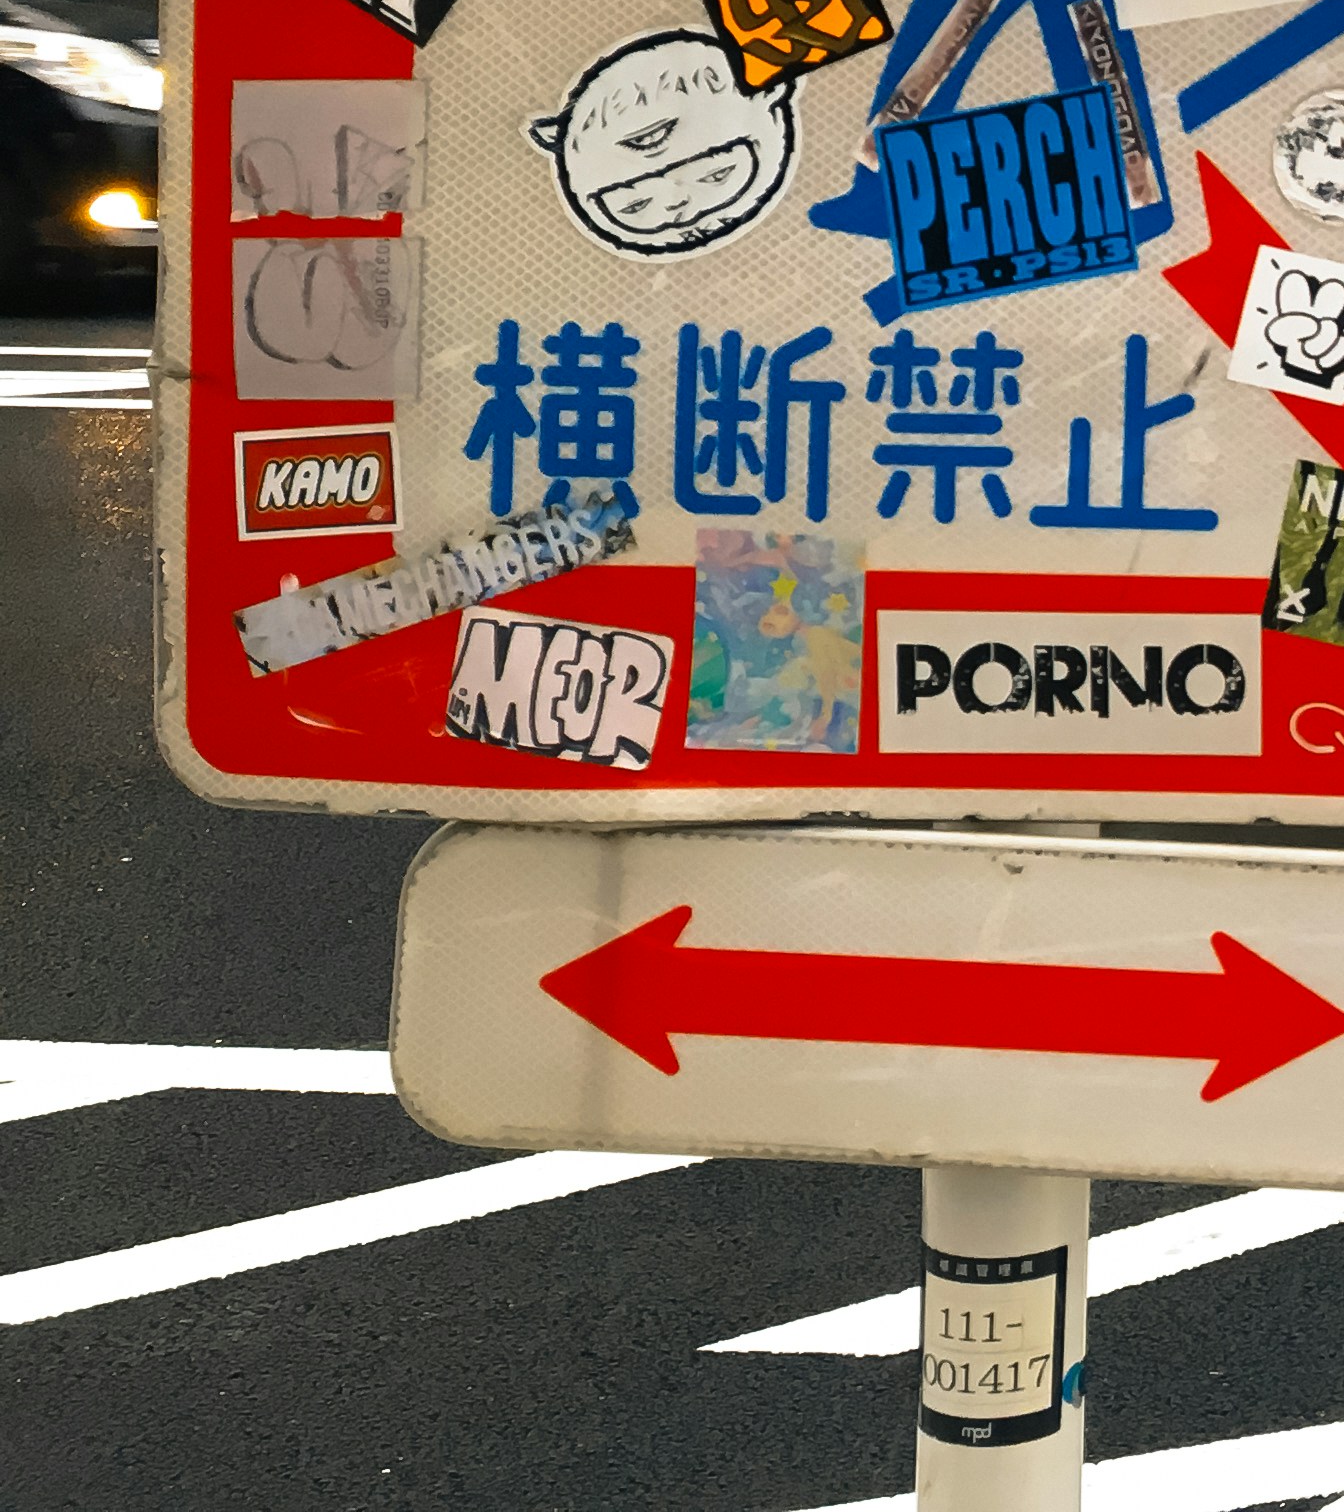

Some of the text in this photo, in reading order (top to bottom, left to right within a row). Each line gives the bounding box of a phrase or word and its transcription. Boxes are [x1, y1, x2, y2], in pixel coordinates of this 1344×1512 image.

[884, 94, 1127, 274] PERCH
[906, 237, 1131, 302] SR PS13
[463, 318, 1218, 531] 横断禁止
[257, 455, 382, 510] KAMO
[896, 642, 1246, 718] PORNO
[938, 1308, 1022, 1343] 111-
[923, 1353, 1050, 1394] 001417
